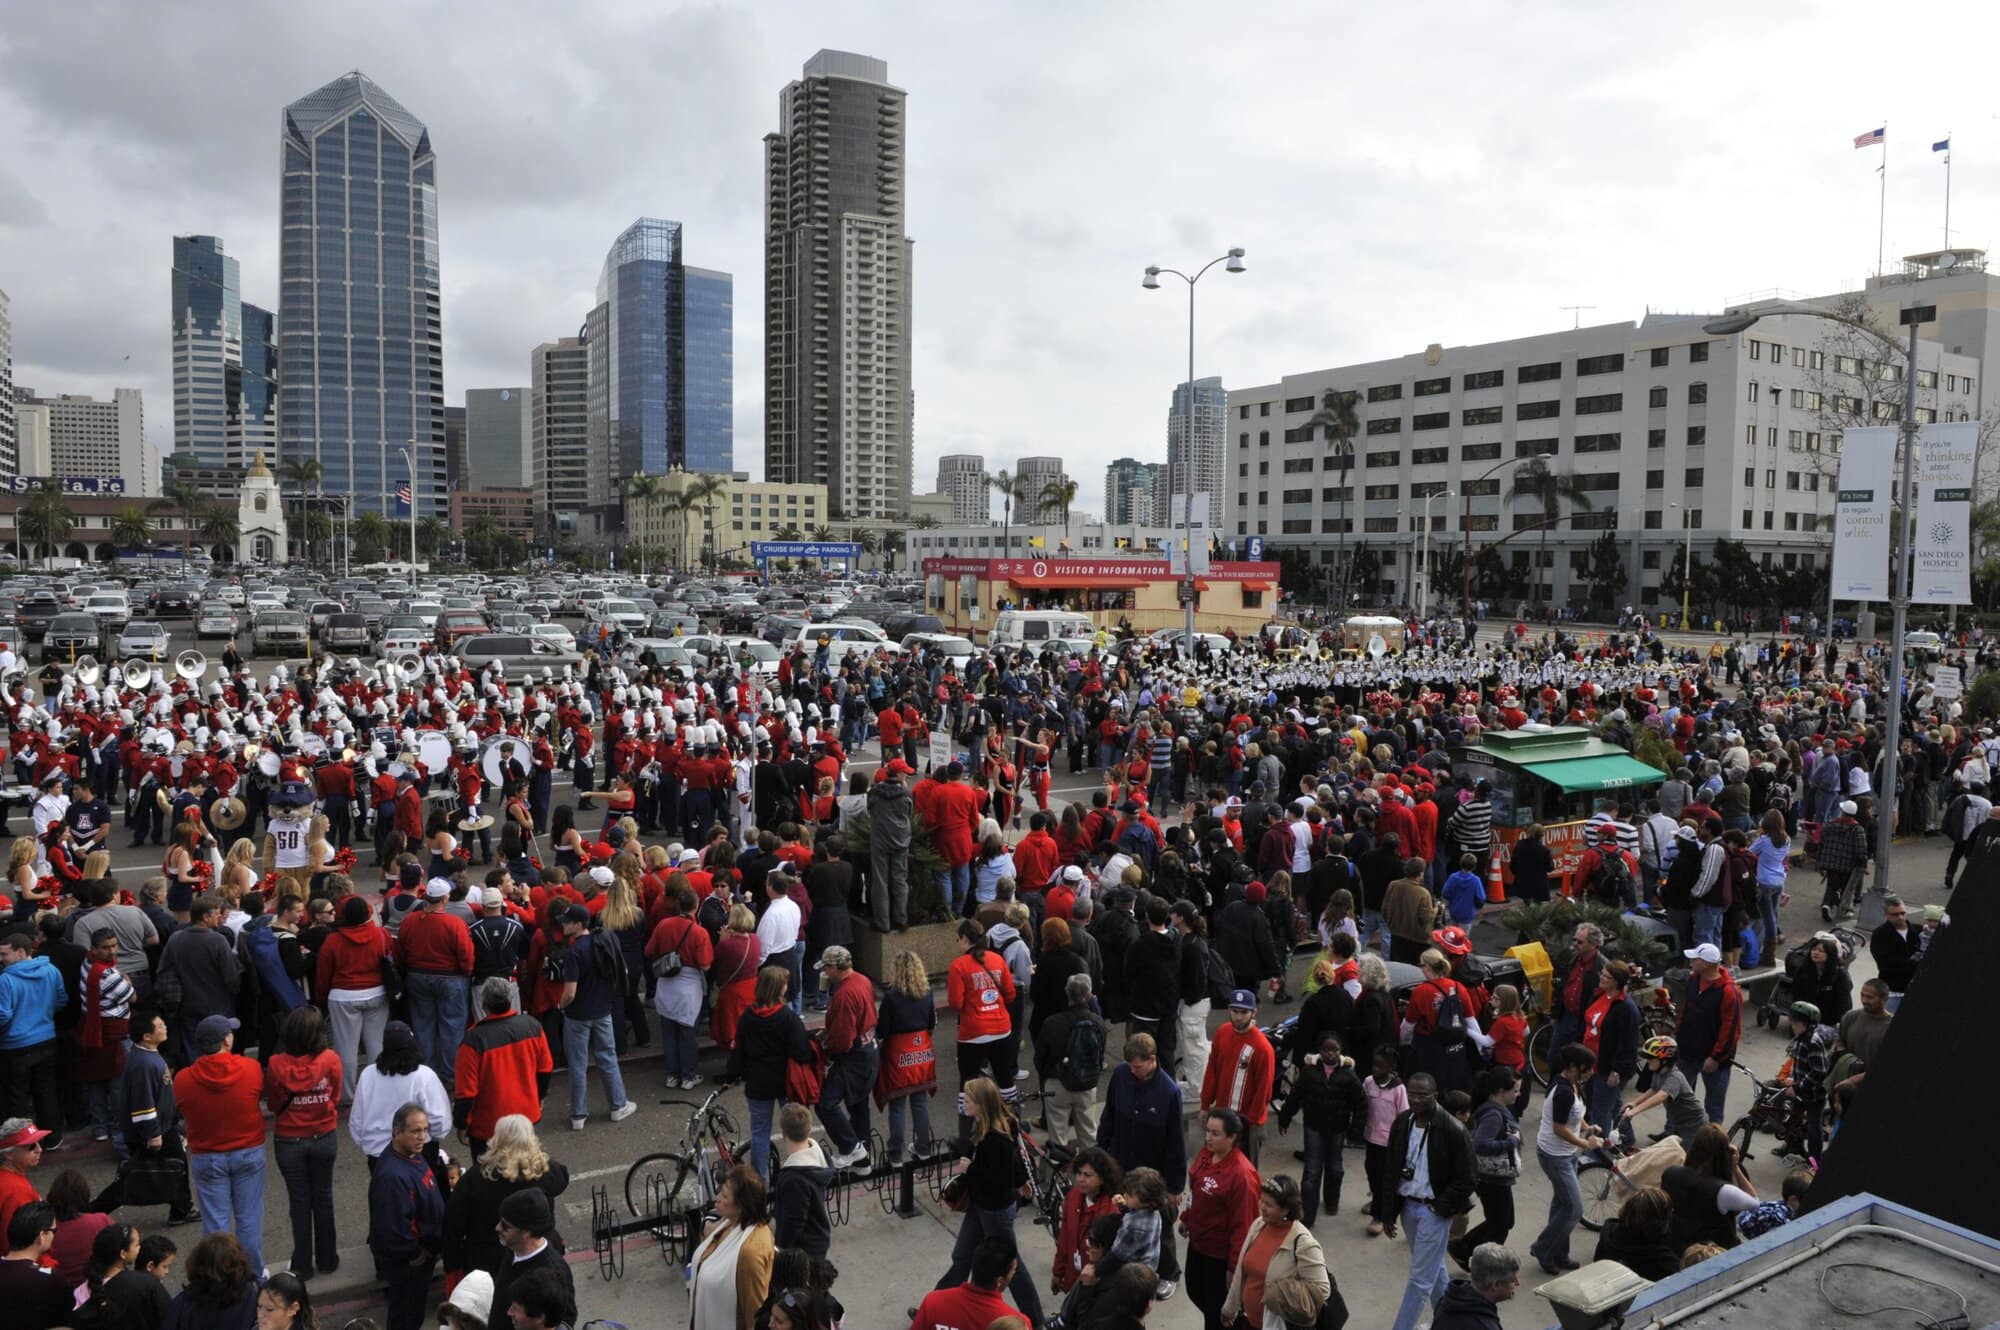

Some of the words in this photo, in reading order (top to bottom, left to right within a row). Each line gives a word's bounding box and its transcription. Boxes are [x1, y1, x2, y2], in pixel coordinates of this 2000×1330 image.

[1926, 450, 1971, 464] thinking
[14, 476, 84, 492] Sata
[97, 479, 121, 492] Fe
[1846, 513, 1883, 525] control
[1251, 539, 1260, 555] 5
[1055, 566, 1094, 575] VISITOR
[1099, 566, 1165, 575] INFORMATION
[1601, 777, 1633, 788] TICKETS
[278, 831, 298, 849] 50
[292, 1094, 329, 1105] ILDCATS
